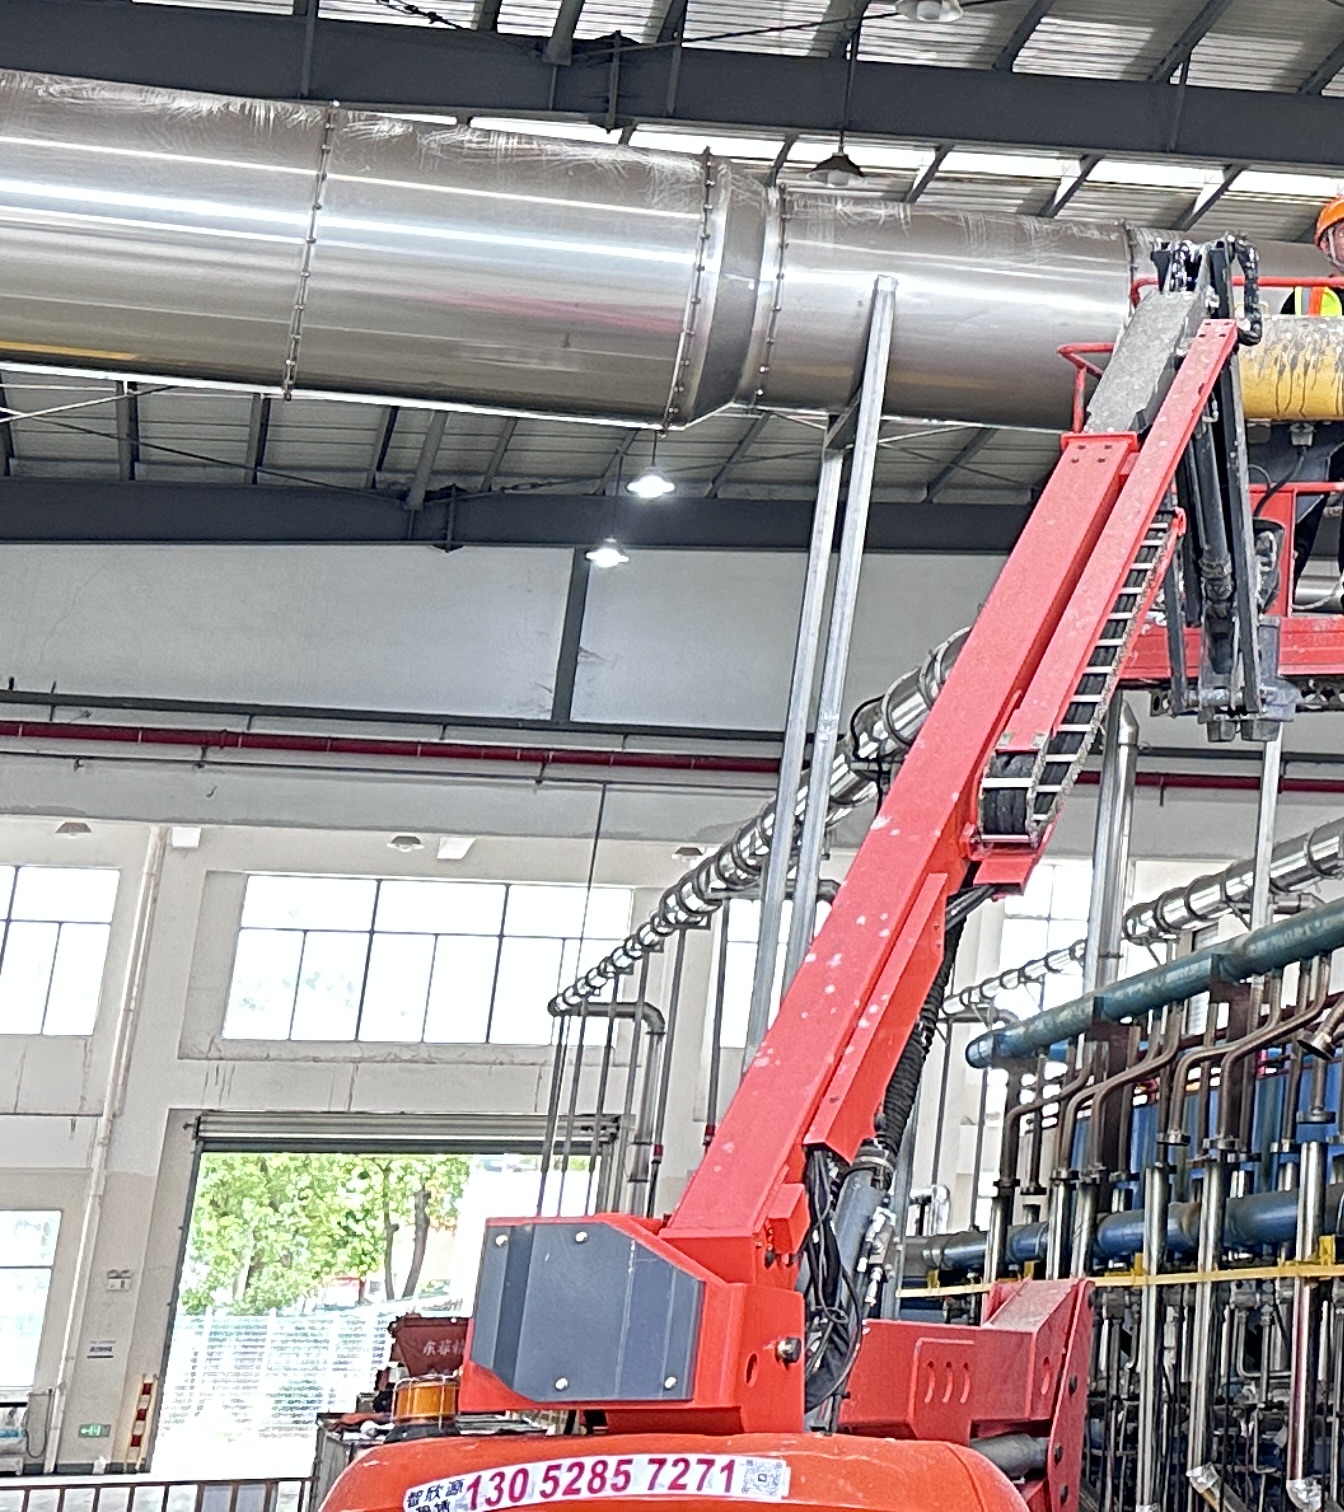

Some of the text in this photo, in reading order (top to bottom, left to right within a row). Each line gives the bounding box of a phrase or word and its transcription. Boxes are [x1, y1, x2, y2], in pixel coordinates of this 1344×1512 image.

[465, 1457, 736, 1510] 130 5285 7271
